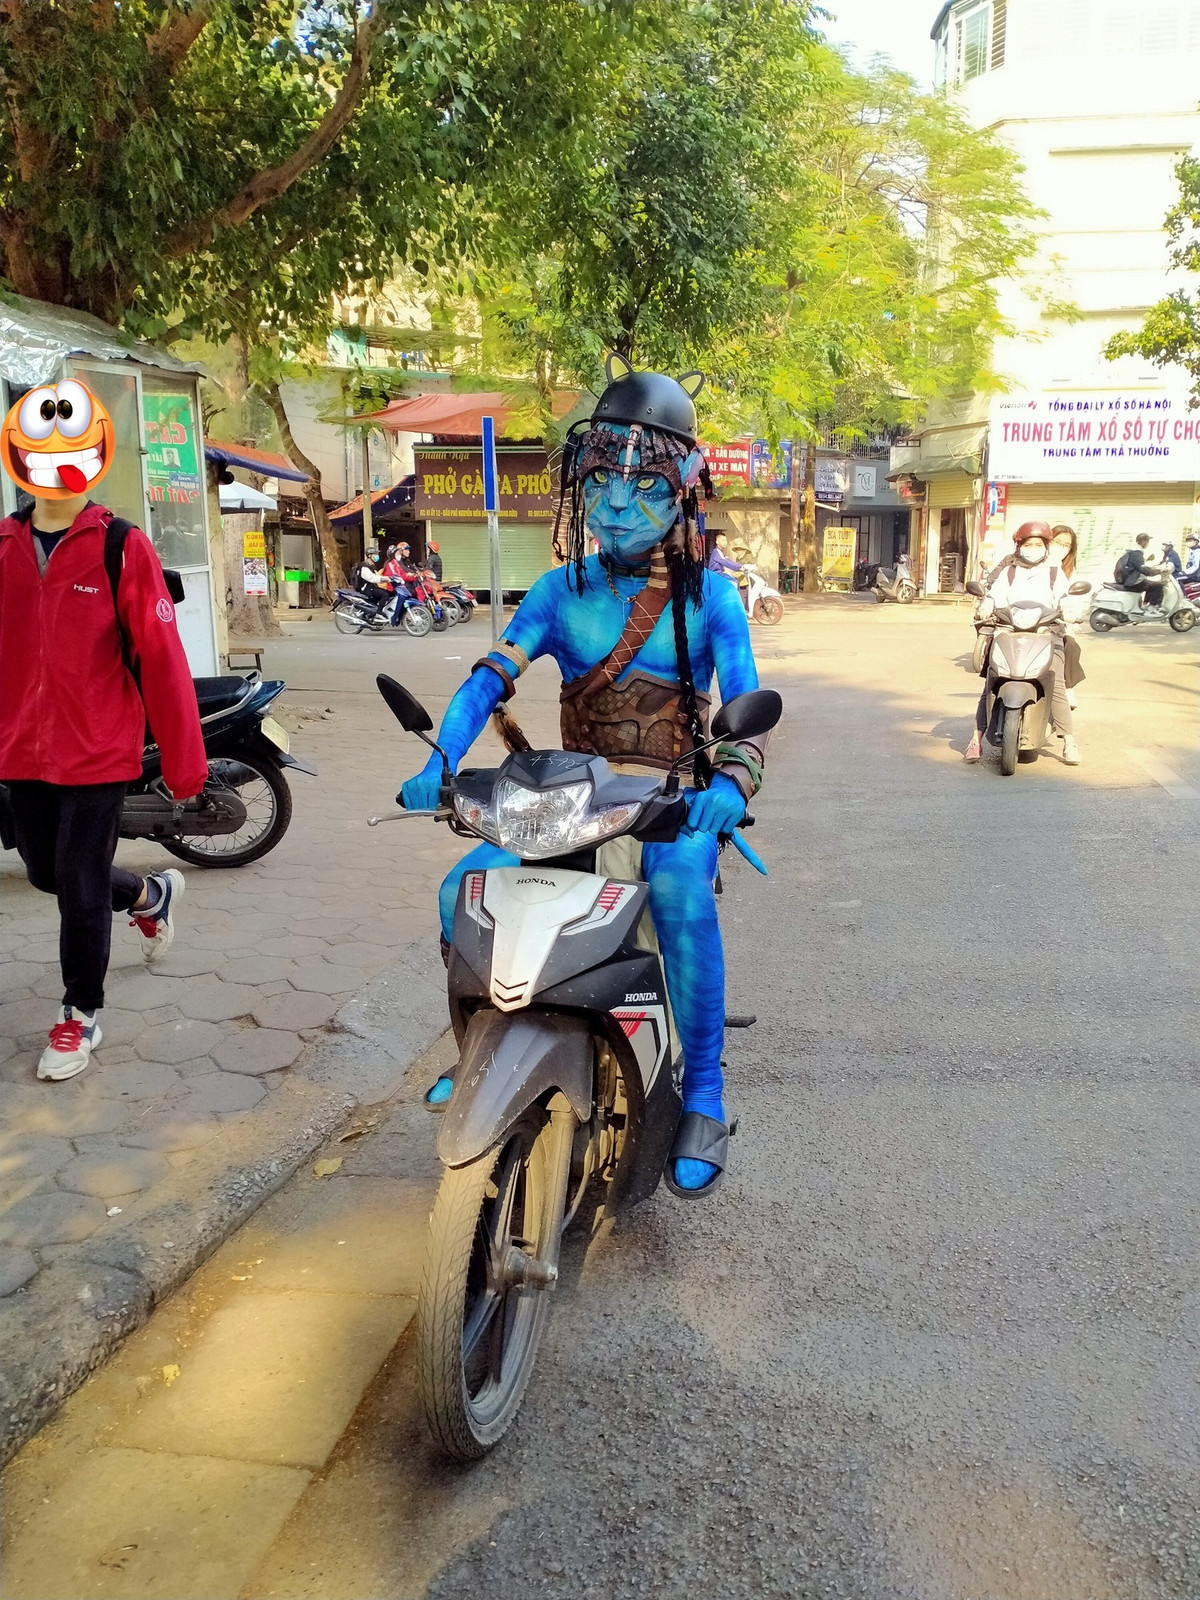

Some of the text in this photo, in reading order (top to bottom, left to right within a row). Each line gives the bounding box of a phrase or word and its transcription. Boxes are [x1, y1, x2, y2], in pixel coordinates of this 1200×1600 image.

[1003, 421, 1053, 442] TRUNG
[1059, 417, 1092, 442] TÂM
[1148, 417, 1170, 445] TỰ
[1043, 448, 1077, 457] TRUNG
[718, 462, 729, 472] XE
[730, 460, 748, 473] MÁY
[422, 466, 457, 495] PHỞ
[461, 468, 484, 495] GÀ
[73, 583, 99, 594] HUST
[516, 877, 557, 887] HONDA
[624, 991, 658, 1003] HONDA
